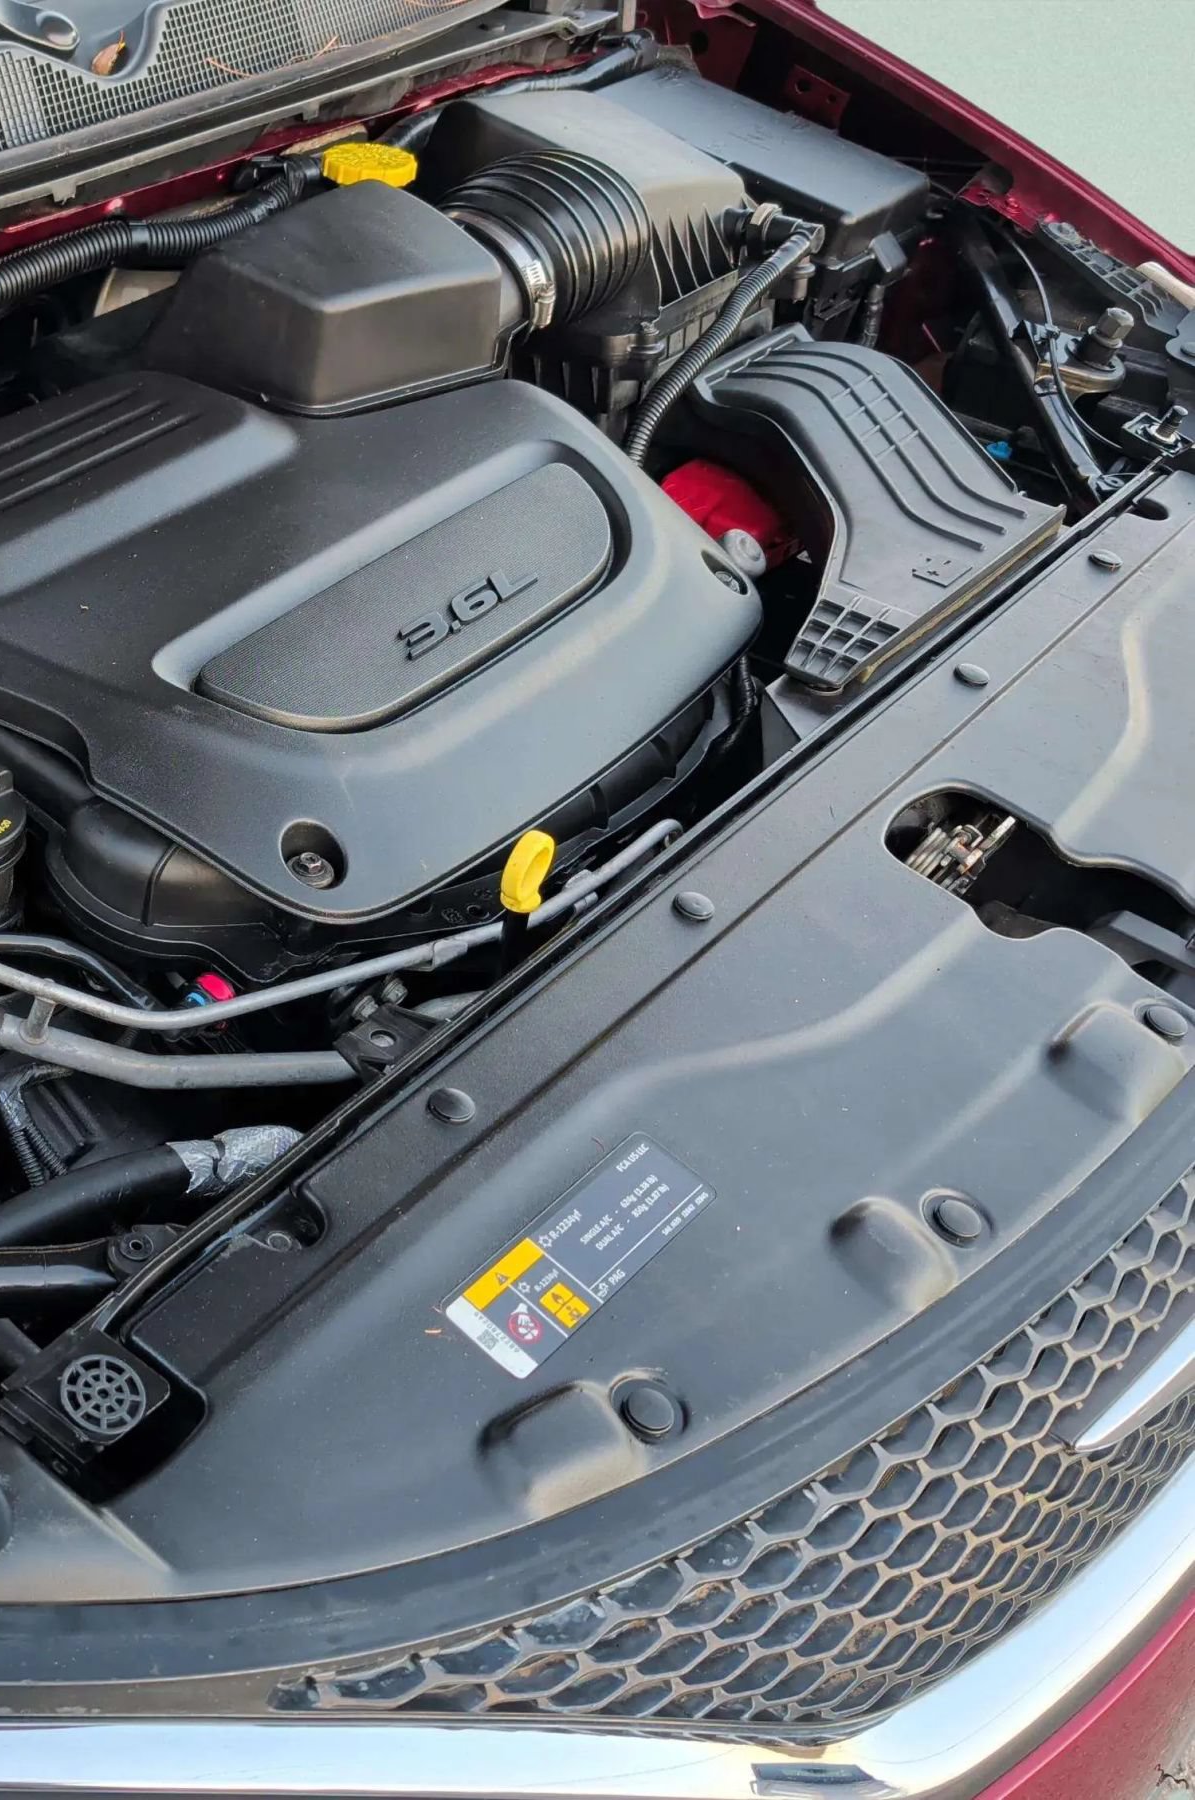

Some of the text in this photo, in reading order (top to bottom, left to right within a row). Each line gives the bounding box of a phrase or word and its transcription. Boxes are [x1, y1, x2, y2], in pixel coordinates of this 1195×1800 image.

[398, 569, 538, 660] 3.6L
[616, 1143, 650, 1173] FCA US LLC
[549, 1208, 583, 1240] R-1234yf
[579, 1223, 602, 1245] SINGLE
[599, 1214, 613, 1228] A/C
[595, 1234, 614, 1251] DUAL
[611, 1223, 625, 1237] A/C
[608, 1268, 626, 1286] PAG
